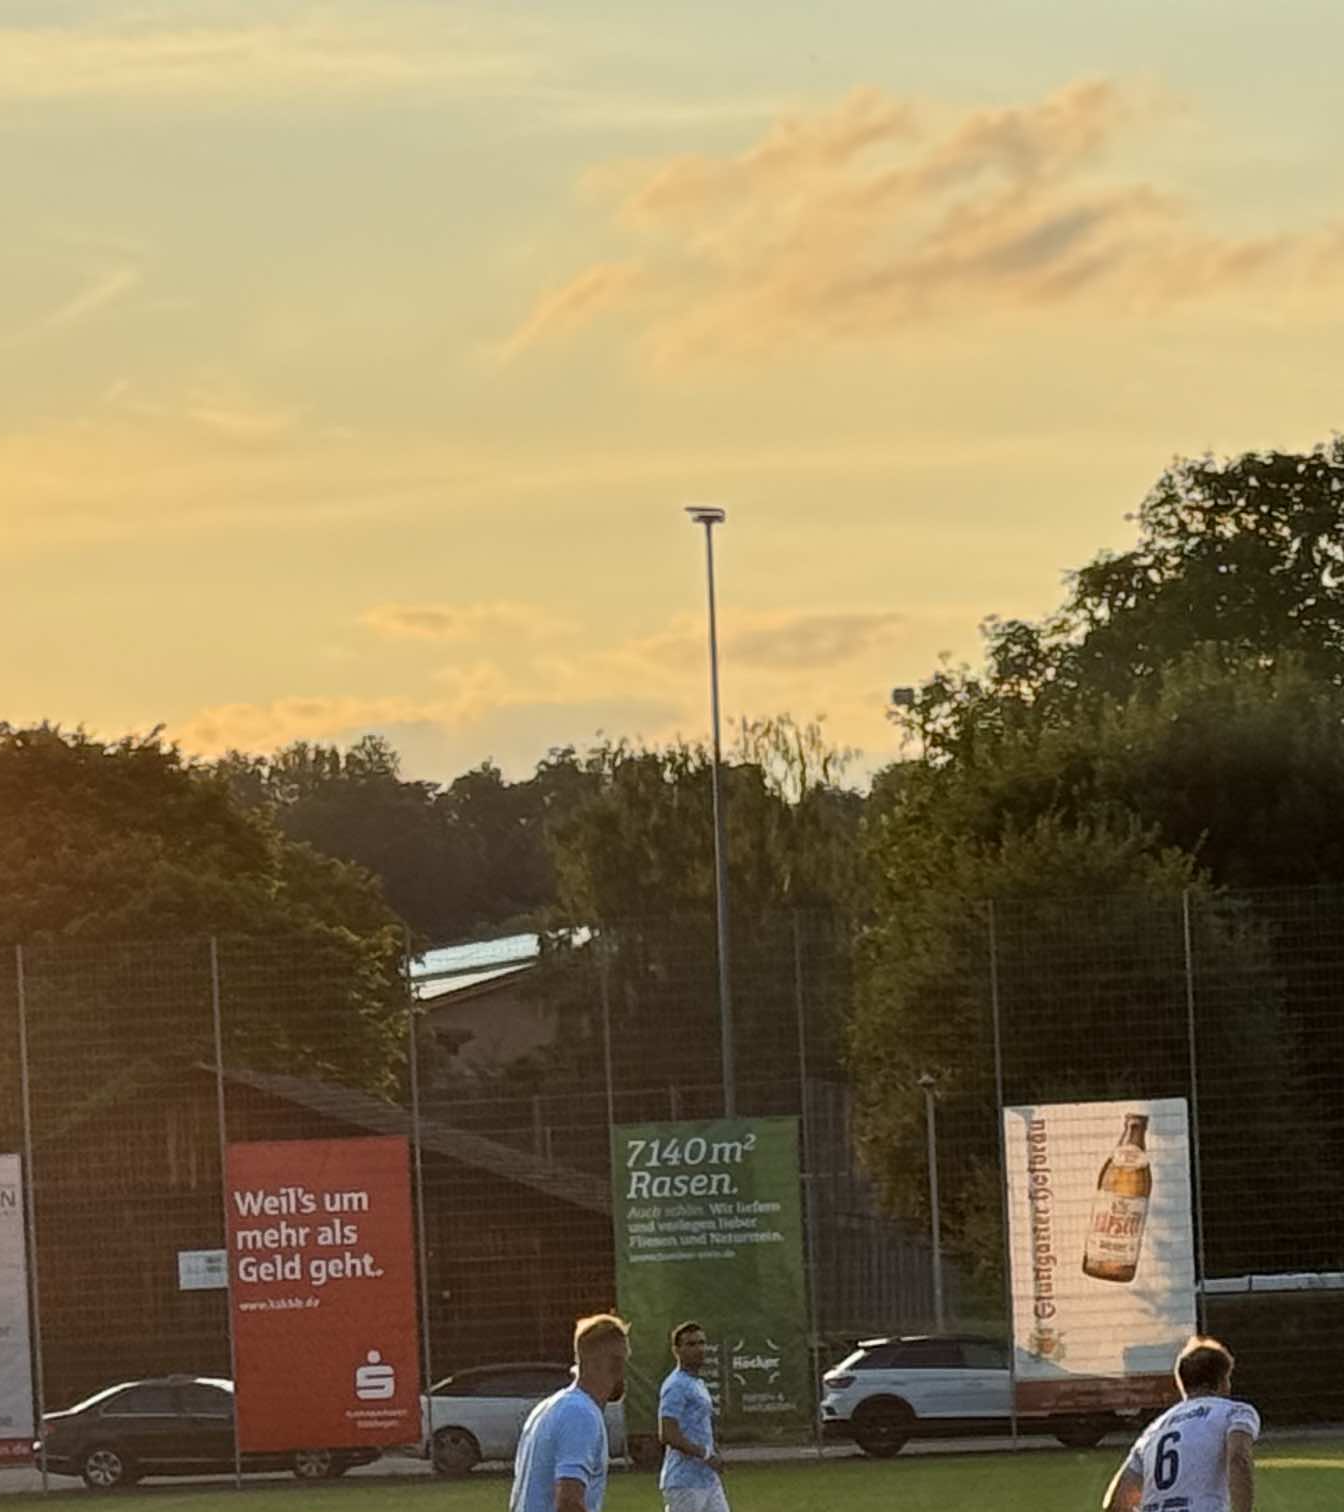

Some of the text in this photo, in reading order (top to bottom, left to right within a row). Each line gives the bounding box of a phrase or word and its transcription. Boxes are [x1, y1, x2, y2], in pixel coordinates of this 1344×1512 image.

[626, 1169, 739, 1200] Rasen.
[233, 1187, 369, 1217] Weil's um
[708, 1202, 734, 1214] Wir
[236, 1218, 358, 1250] mehr als
[627, 1220, 656, 1233] und
[718, 1216, 757, 1229] lieber
[679, 1233, 707, 1246] und
[238, 1251, 385, 1286] Geld geht.
[1154, 1431, 1181, 1491] 6
